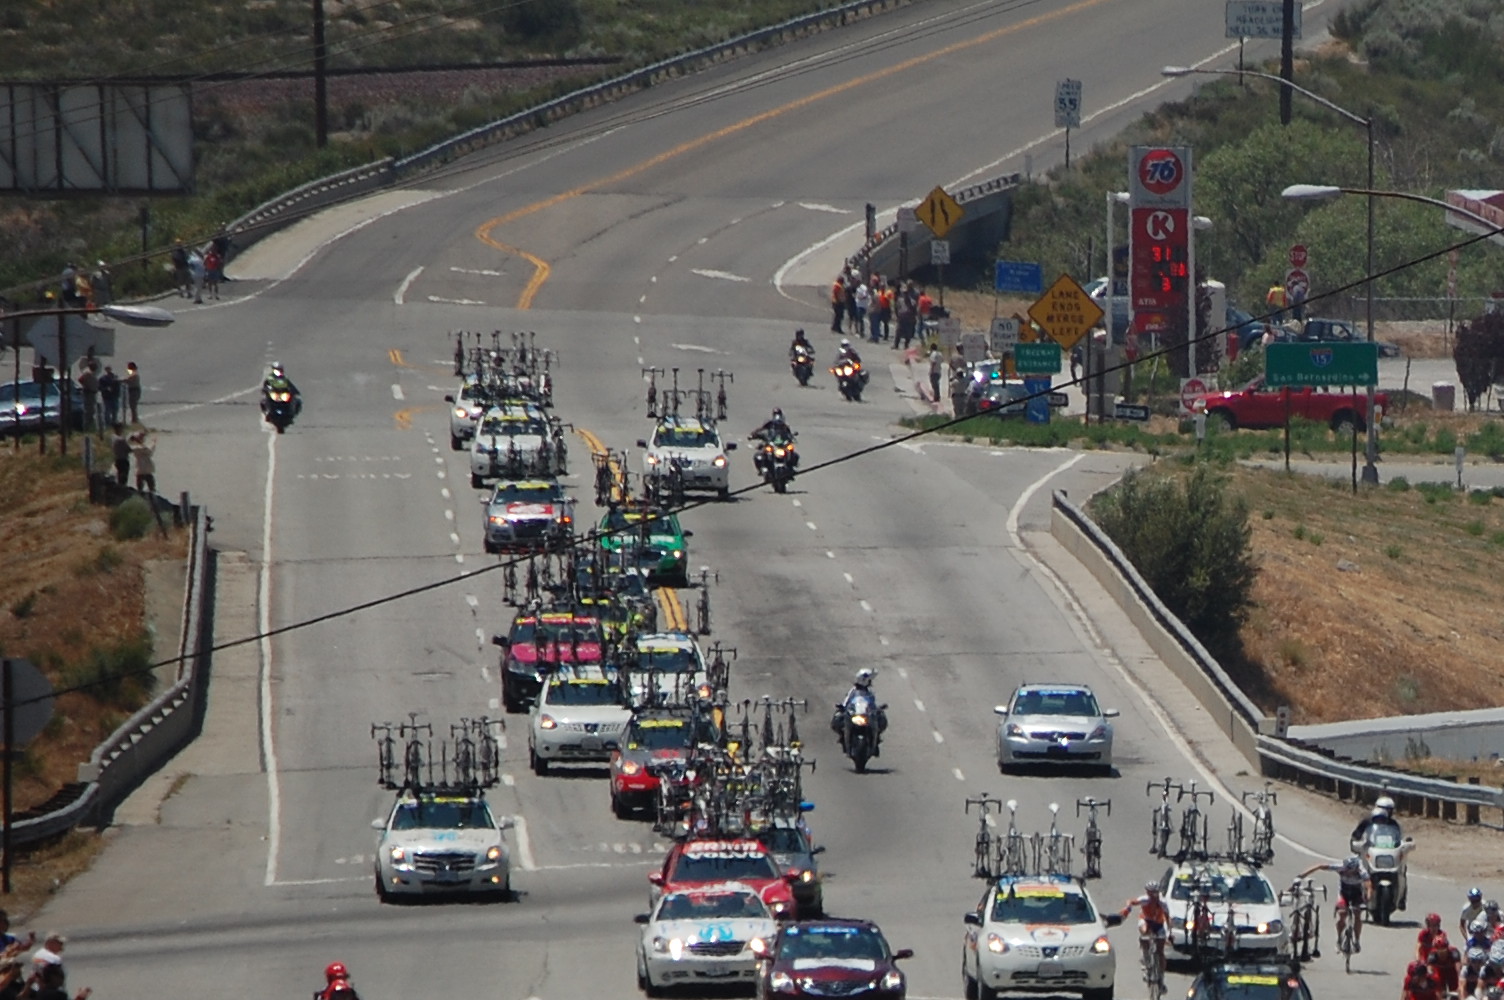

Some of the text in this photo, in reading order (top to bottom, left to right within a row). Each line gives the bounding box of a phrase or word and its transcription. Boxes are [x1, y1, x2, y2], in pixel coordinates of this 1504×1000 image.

[1146, 158, 1176, 183] 76
[1051, 289, 1079, 299] LANE
[1315, 354, 1328, 366] 15
[686, 851, 765, 860] VOLVO
